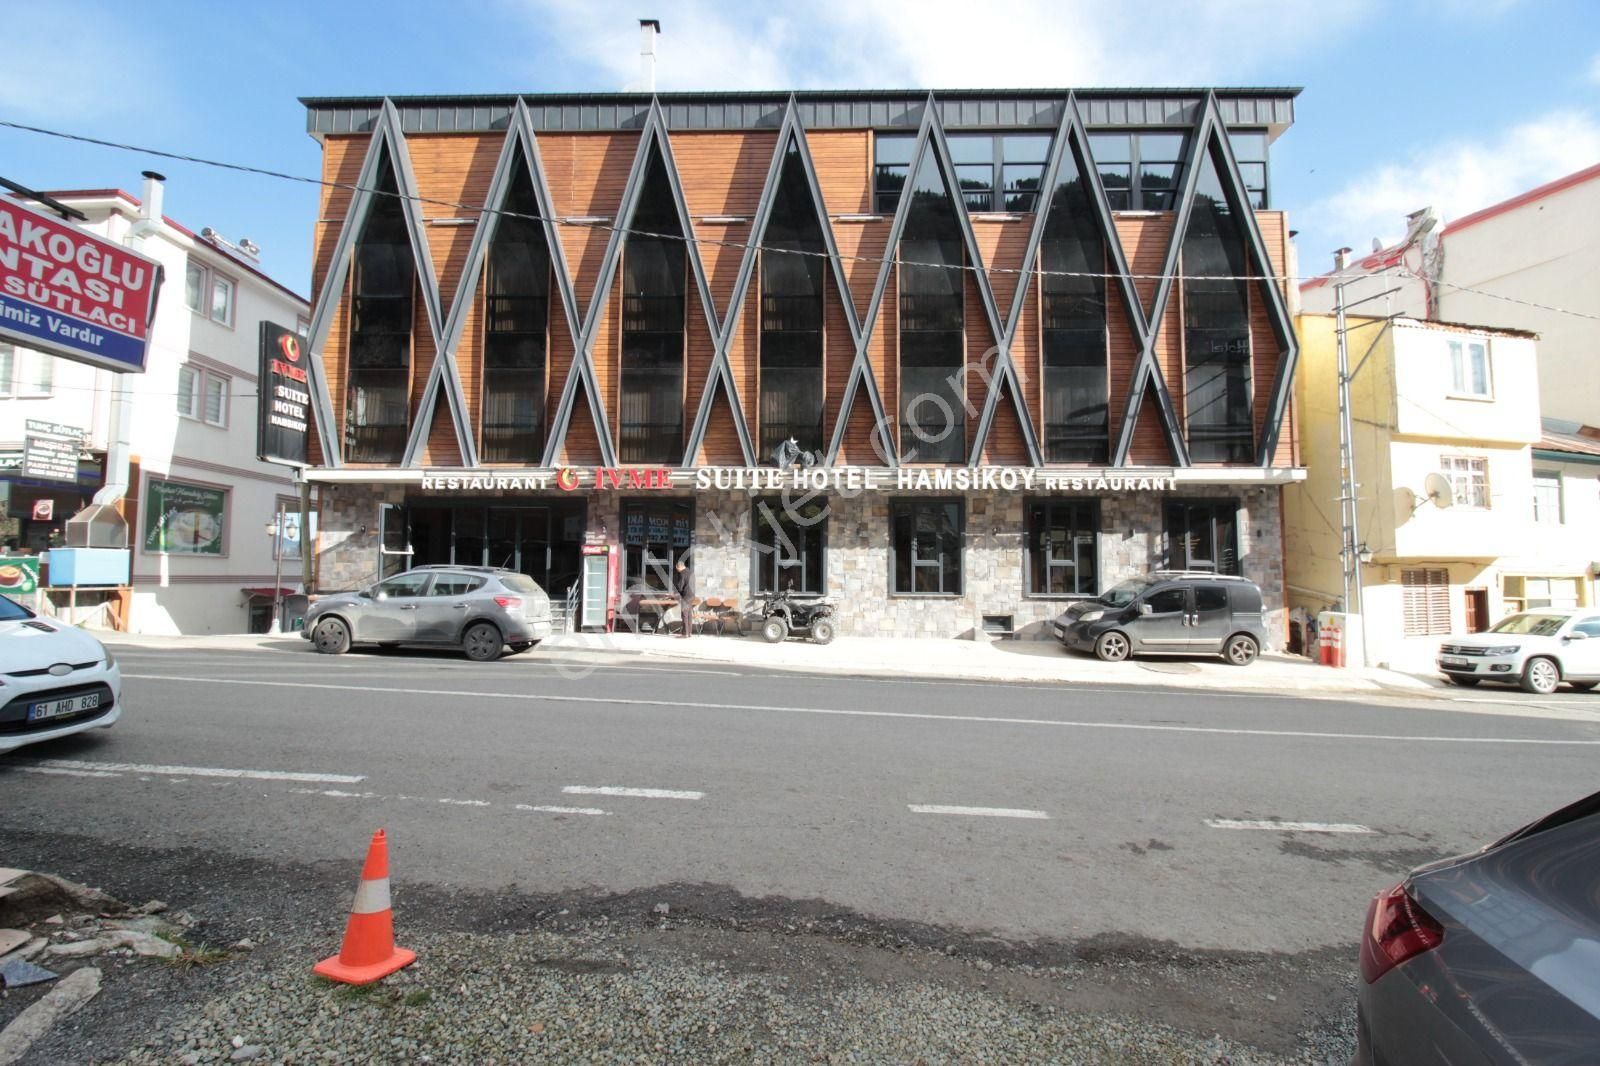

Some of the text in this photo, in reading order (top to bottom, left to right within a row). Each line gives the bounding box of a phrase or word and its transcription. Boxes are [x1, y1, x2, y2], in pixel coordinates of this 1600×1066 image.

[4, 276, 136, 334] SÜTLACI
[47, 316, 104, 346] Vardır
[277, 386, 309, 405] SUITE
[274, 400, 305, 419] HOTEL
[421, 476, 548, 490] RESTAURANT
[695, 468, 784, 490] SUITE
[793, 468, 878, 490] HOTEL
[1045, 477, 1177, 490] RESTAURANT
[37, 704, 48, 717] 61
[56, 700, 73, 714] AHD
[81, 695, 98, 708] 828
